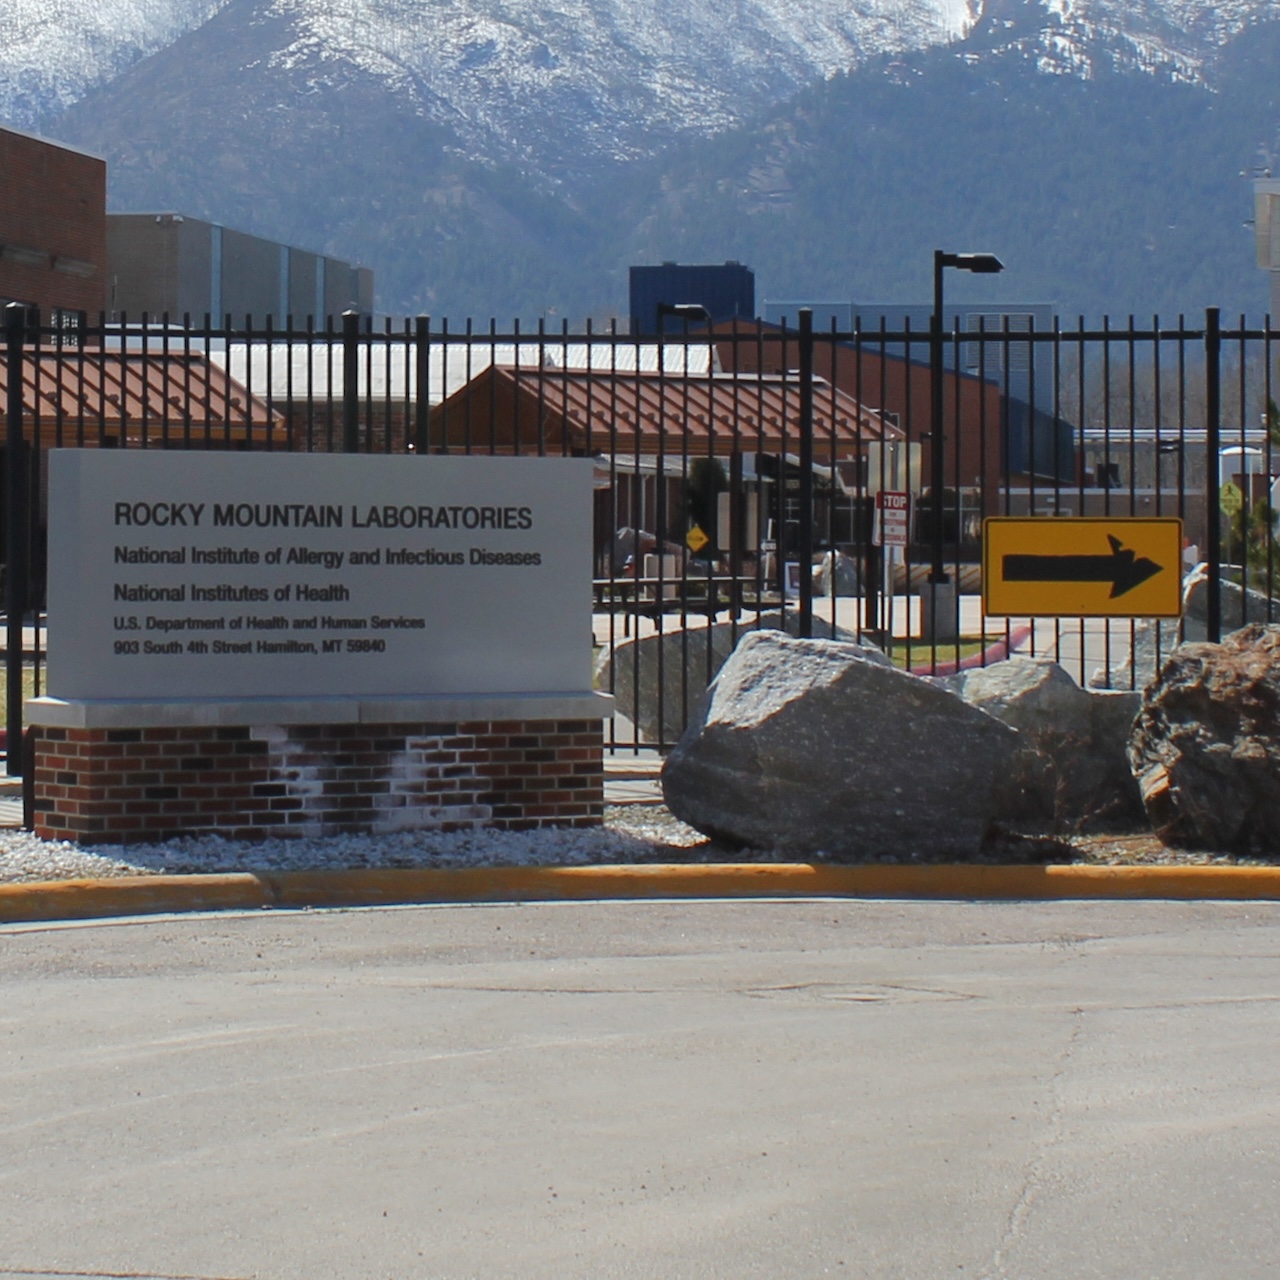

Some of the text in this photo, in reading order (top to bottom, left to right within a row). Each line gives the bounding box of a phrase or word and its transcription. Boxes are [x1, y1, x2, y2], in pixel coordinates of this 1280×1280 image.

[115, 503, 532, 529] ROCKY MOUNTAIN LABORATORIES
[115, 546, 541, 569] National Institute of Allergy and Infectious Diseases
[114, 584, 349, 601] National Institutes of Health
[114, 616, 425, 632] U.S. Department of Health and Human Services
[114, 639, 385, 655] 903 South 4th Street Hamilton, MT 59840
